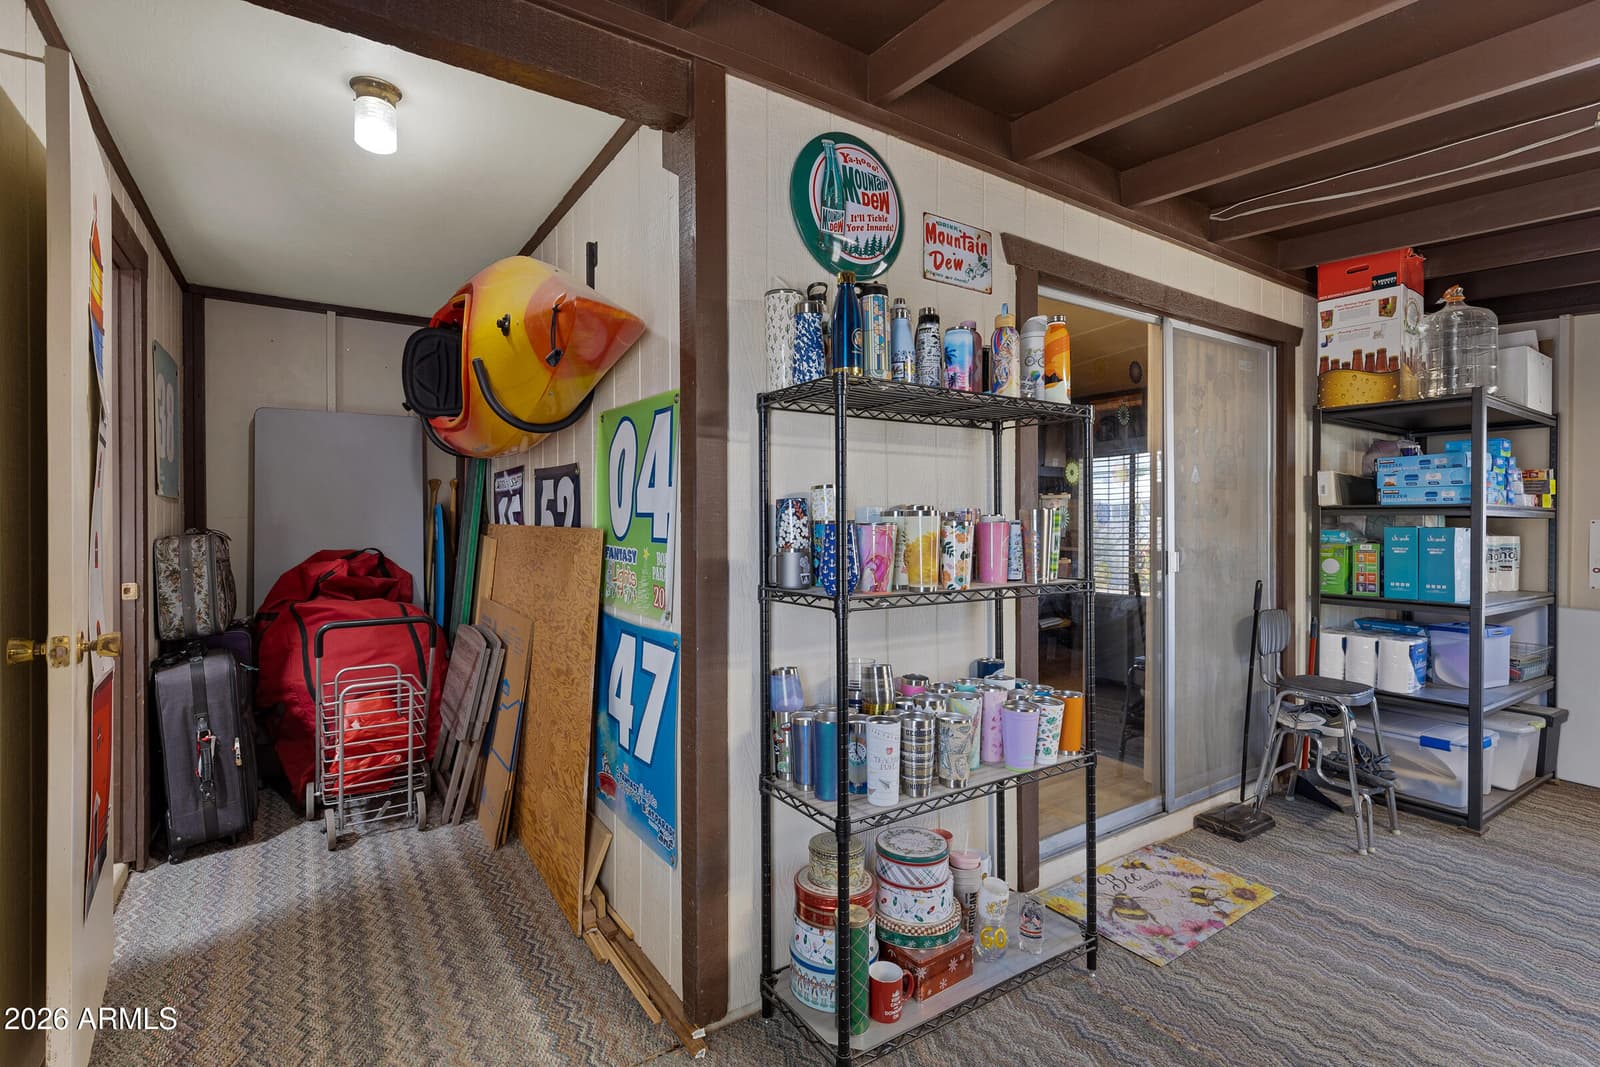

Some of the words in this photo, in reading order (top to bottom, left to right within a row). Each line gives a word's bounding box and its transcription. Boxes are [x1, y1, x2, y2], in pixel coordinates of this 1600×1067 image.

[846, 224, 866, 233] Yore
[866, 214, 889, 223] Tickle
[925, 222, 988, 257] Mountain
[928, 250, 964, 272] Dew
[609, 405, 674, 544] 04
[604, 546, 638, 565] FANTASY
[608, 633, 676, 765] 47
[1097, 873, 1142, 892] Bee
[967, 892, 978, 938] MERICAN
